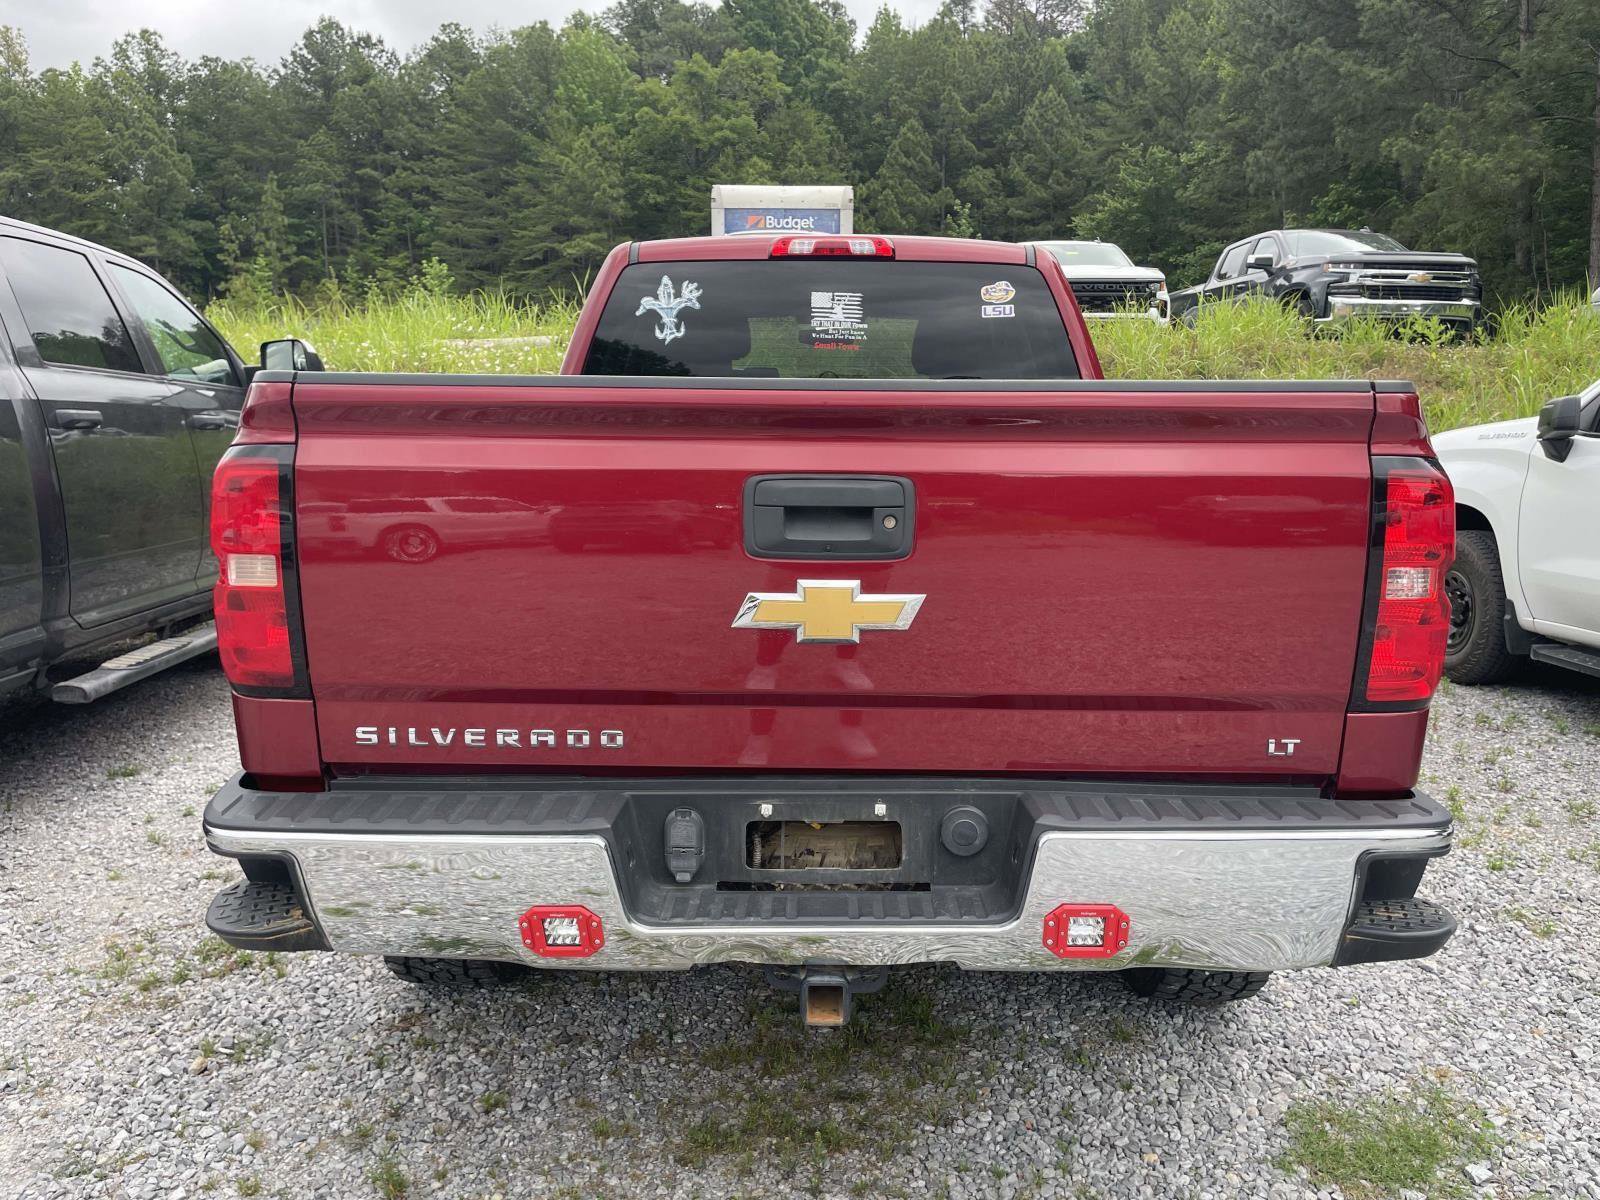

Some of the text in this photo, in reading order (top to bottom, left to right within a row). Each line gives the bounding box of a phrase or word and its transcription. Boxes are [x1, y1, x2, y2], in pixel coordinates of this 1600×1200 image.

[766, 215, 815, 230] Budget
[983, 306, 1013, 317] LSU
[355, 726, 624, 748] SILVERADO
[1267, 738, 1301, 757] LT
